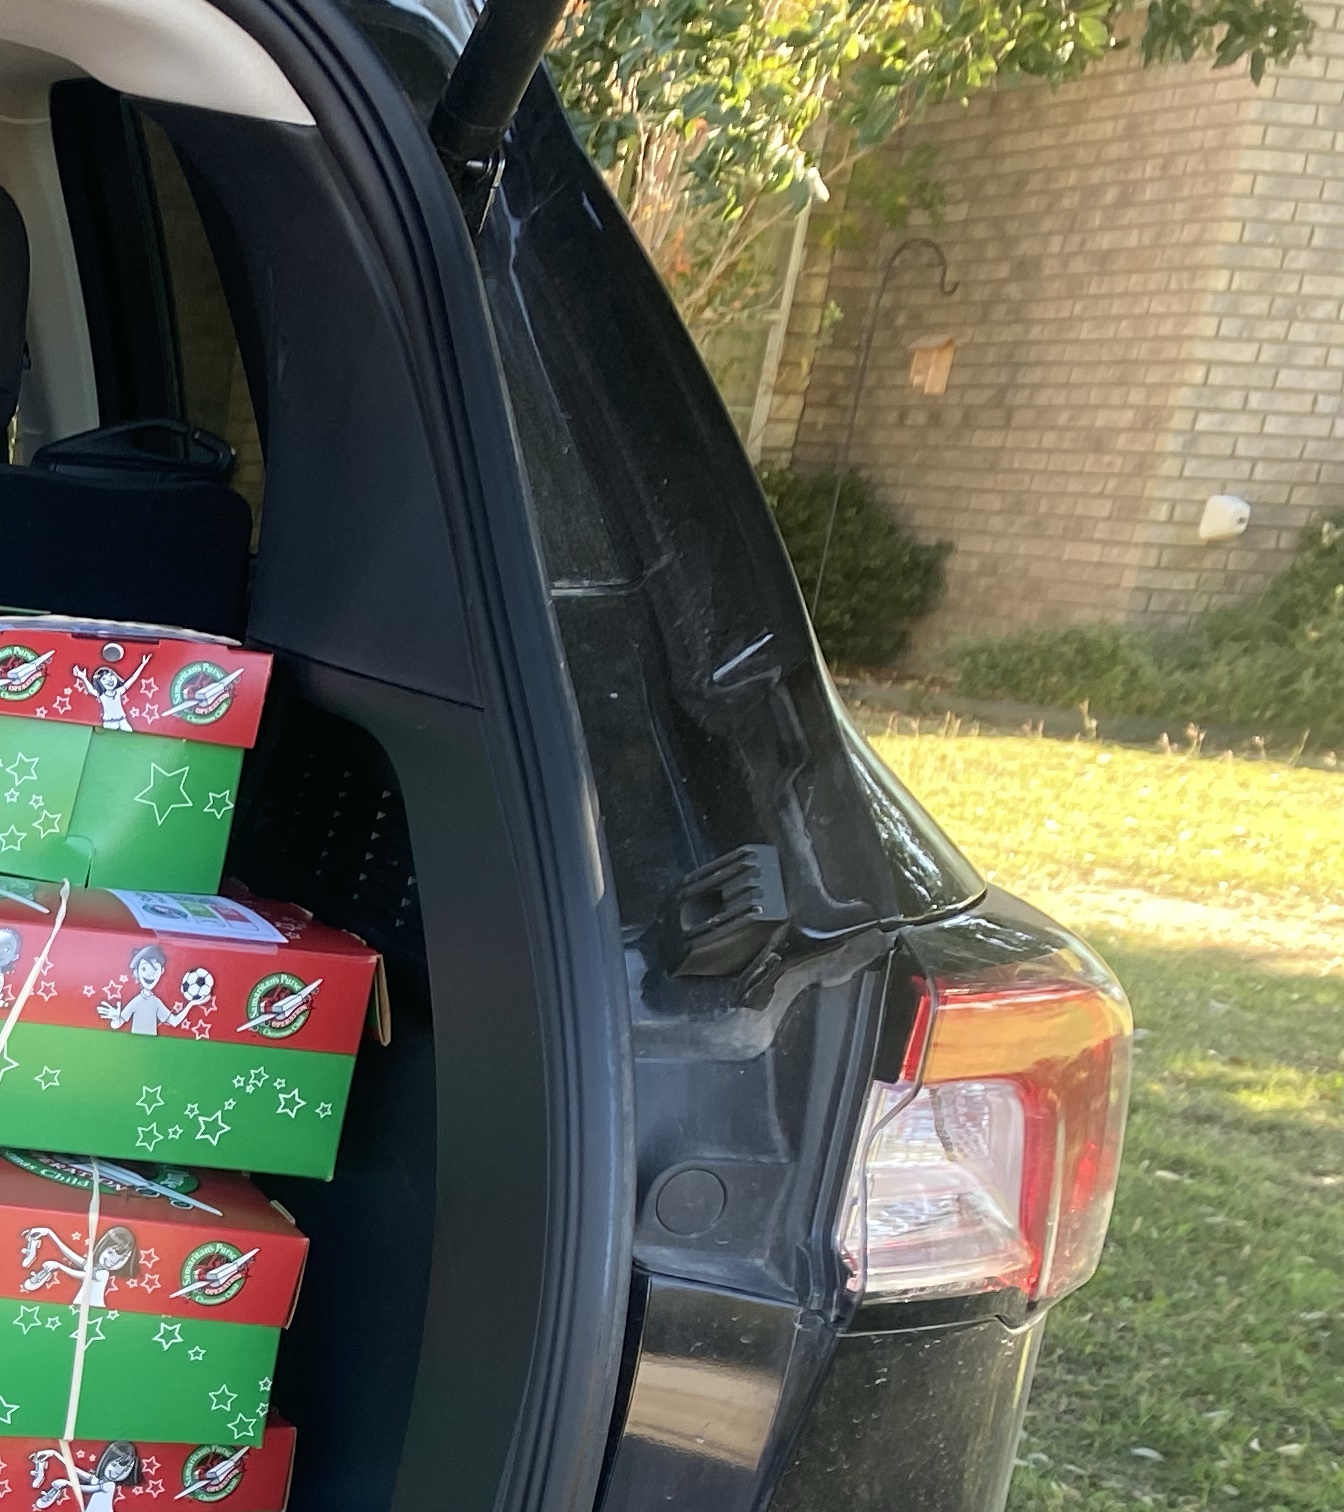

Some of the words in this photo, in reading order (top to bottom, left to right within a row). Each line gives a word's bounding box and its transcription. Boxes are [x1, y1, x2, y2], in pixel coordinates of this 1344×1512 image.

[13, 647, 35, 660] Purse
[202, 663, 224, 679] Purse
[281, 974, 302, 991] Purse
[40, 1169, 90, 1188] Child
[216, 1243, 238, 1260] Purse
